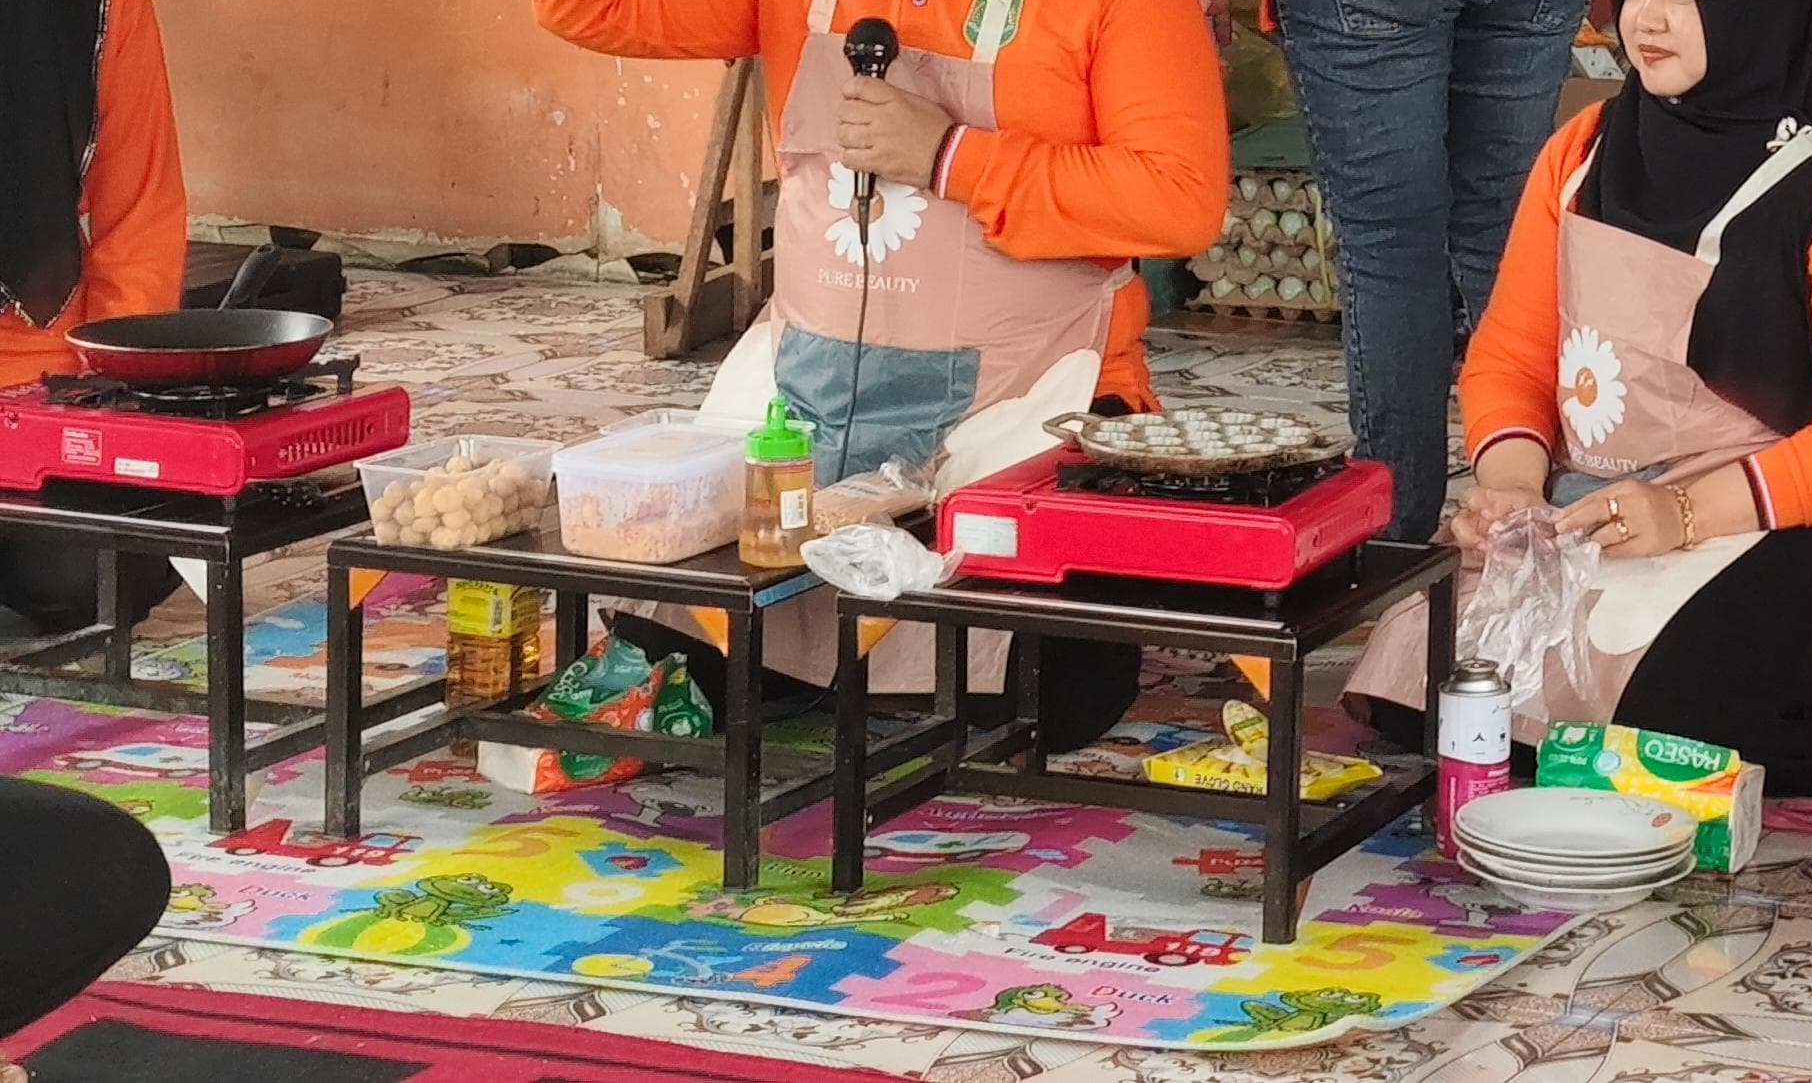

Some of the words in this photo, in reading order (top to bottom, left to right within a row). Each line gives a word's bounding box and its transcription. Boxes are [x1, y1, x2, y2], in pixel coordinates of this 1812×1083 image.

[817, 268, 853, 288] PURE
[855, 273, 920, 293] BEAUTY
[1584, 454, 1638, 473] BEAUTY
[238, 884, 317, 903] Duck
[1004, 946, 1057, 962] Fire
[1064, 956, 1162, 974] engine
[1090, 985, 1175, 1005] Duck
